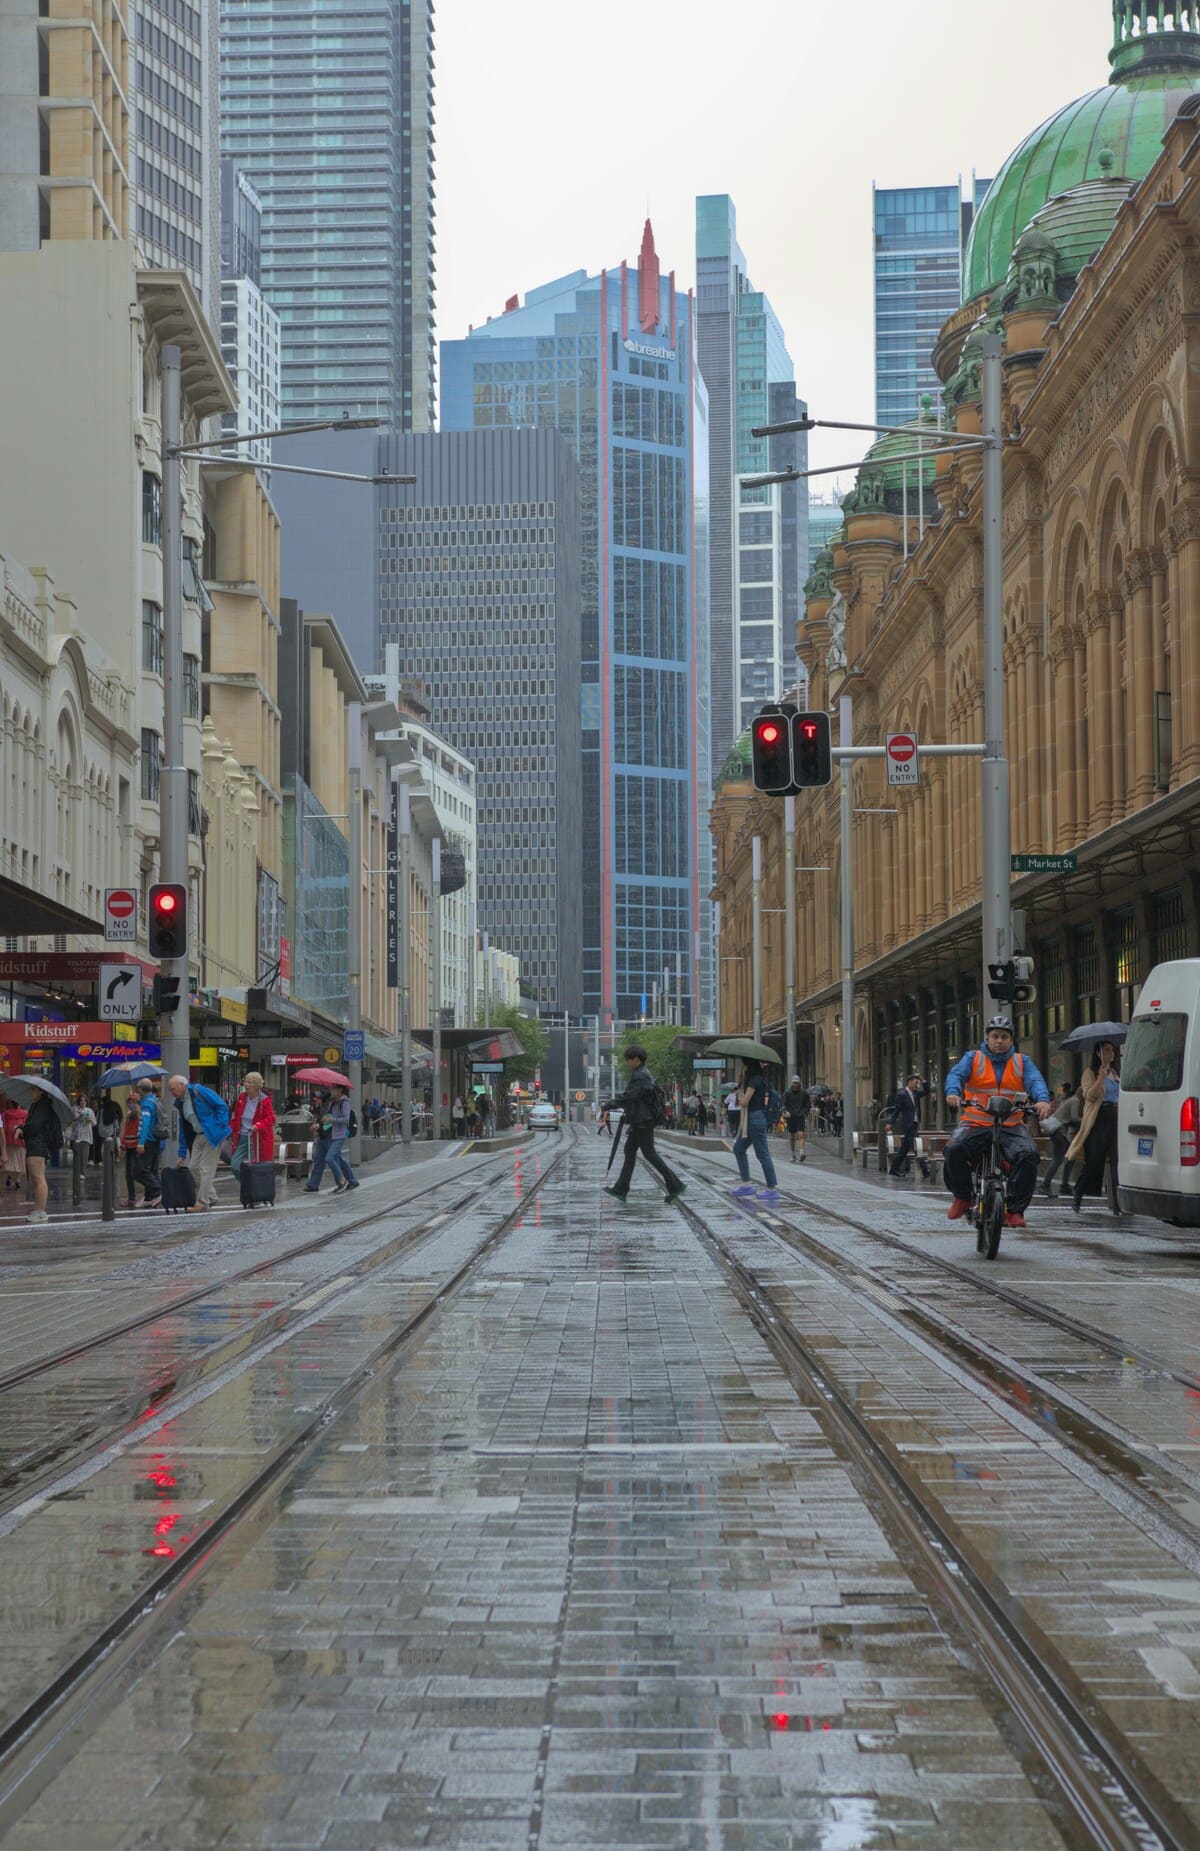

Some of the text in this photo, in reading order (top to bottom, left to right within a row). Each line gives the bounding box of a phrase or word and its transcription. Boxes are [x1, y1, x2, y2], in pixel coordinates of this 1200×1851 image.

[635, 340, 675, 360] breathe
[895, 764, 910, 773] NO
[889, 774, 916, 782] ENTRY
[1028, 859, 1073, 868] Market St
[387, 851, 397, 963] GALERIES
[113, 920, 129, 929] NO
[107, 930, 134, 938] ENTRY
[0, 959, 49, 974] idstuff
[103, 1004, 137, 1015] ONLY
[24, 1023, 79, 1037] Kidstuff
[92, 1046, 145, 1058] EzyMart
[349, 1046, 360, 1055] 20
